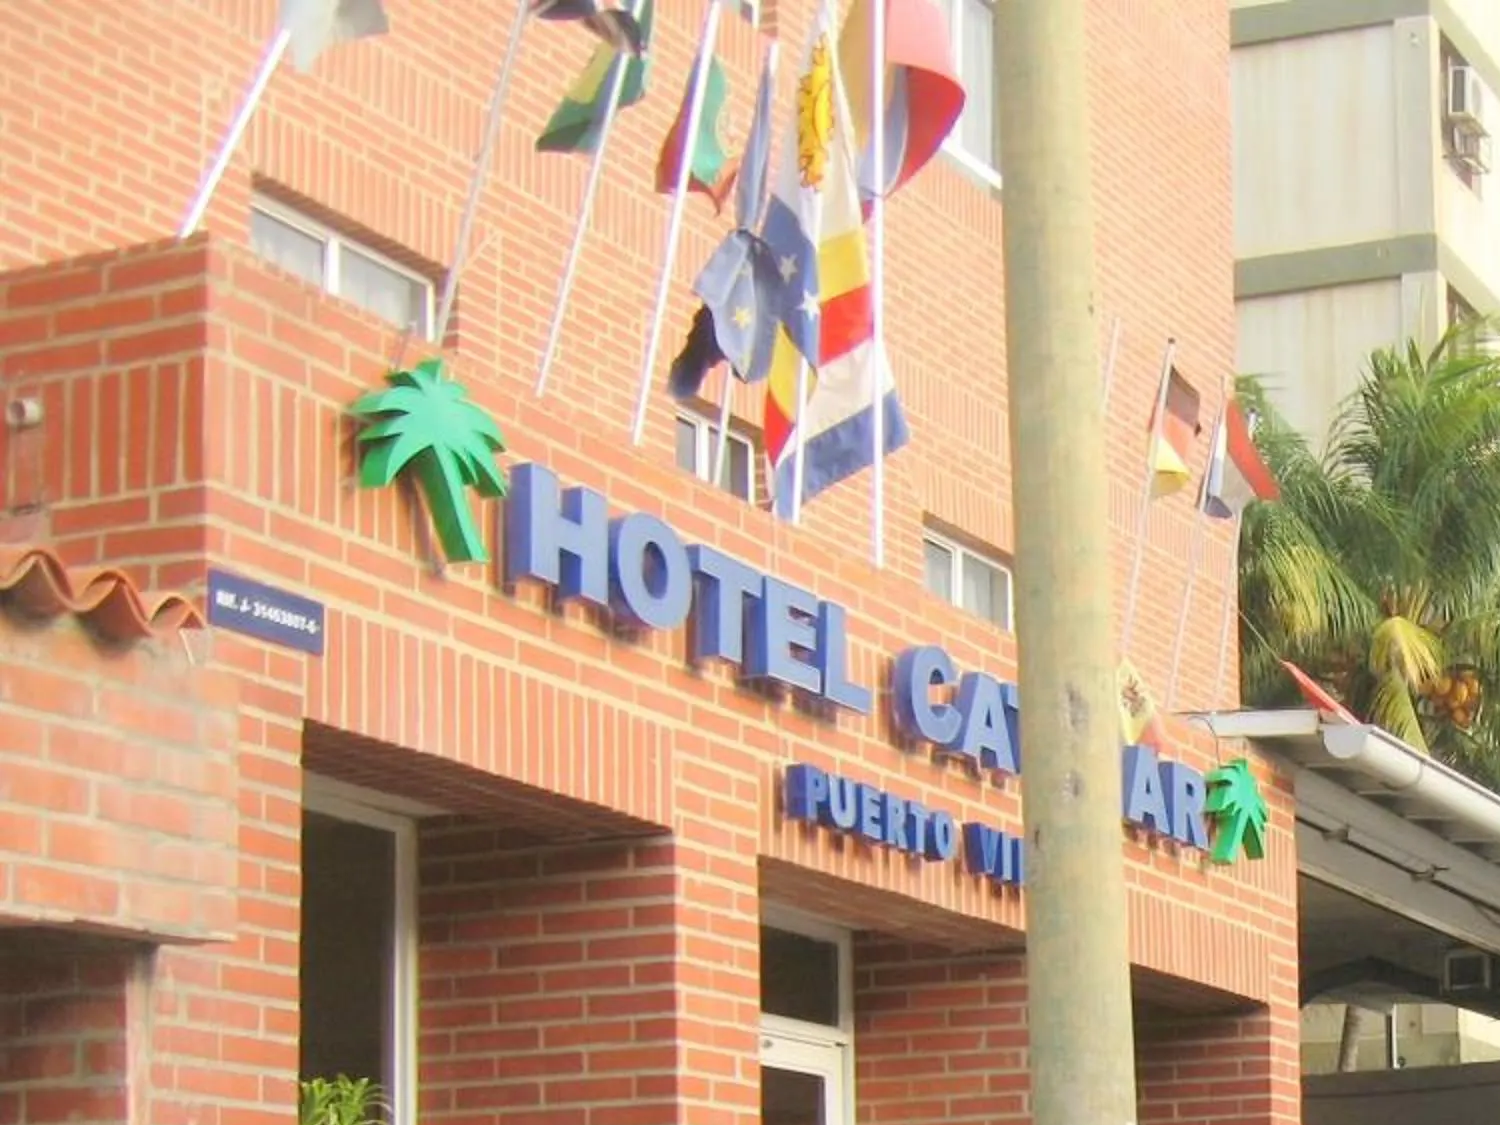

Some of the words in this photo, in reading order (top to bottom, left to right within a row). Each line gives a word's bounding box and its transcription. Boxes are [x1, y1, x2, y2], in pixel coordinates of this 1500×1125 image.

[509, 462, 873, 715] HOTEL
[892, 645, 1211, 852] CAAR
[784, 763, 956, 862] PUERTO
